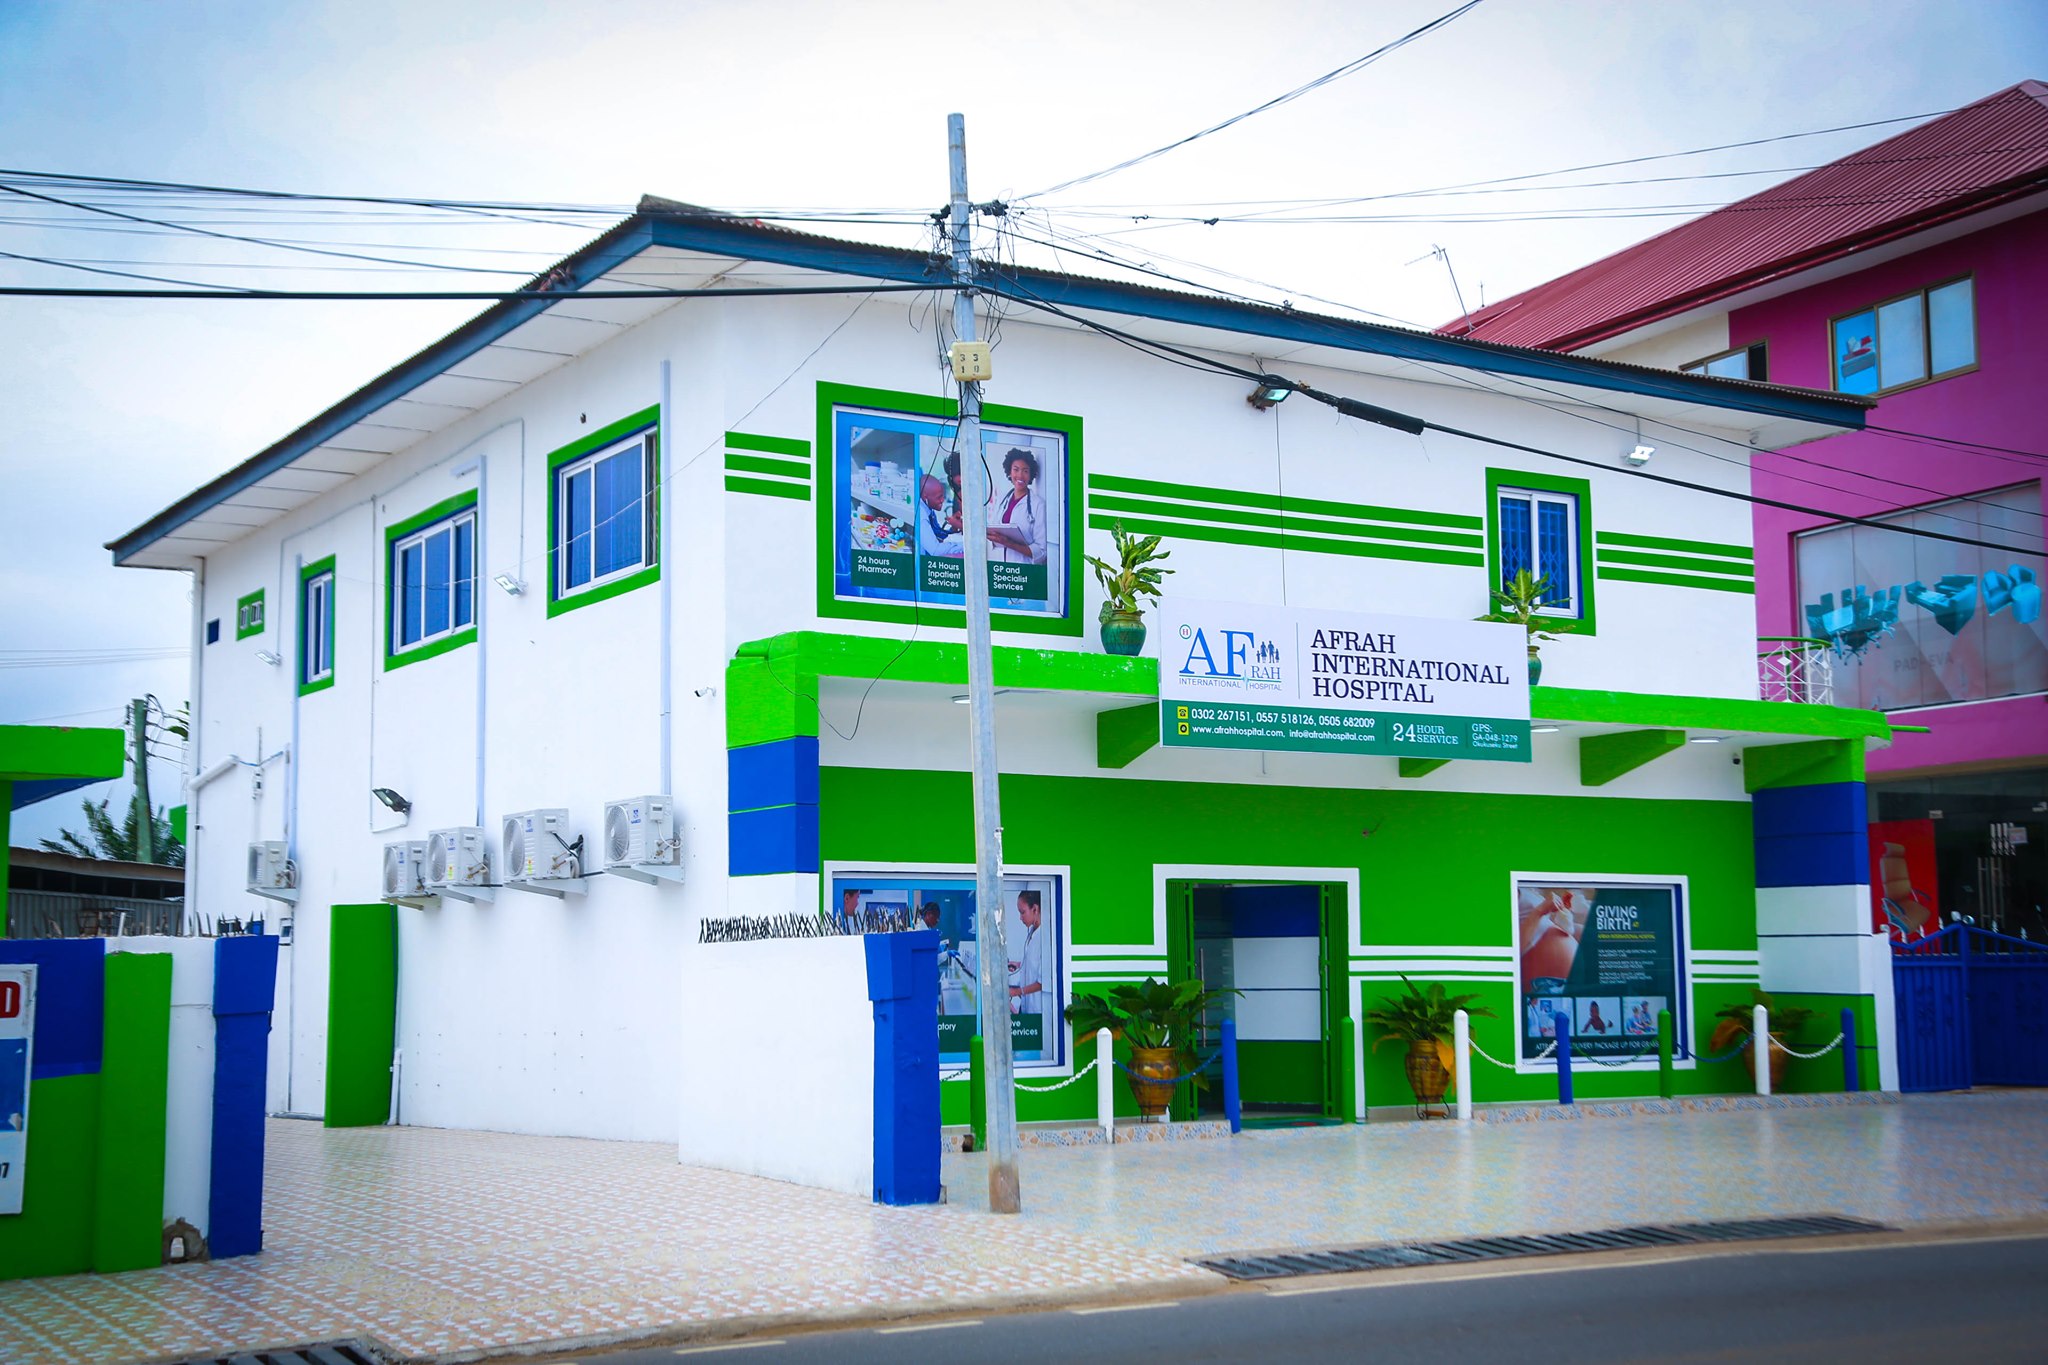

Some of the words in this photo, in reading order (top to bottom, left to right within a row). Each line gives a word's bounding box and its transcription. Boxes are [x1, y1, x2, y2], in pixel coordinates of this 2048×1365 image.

[857, 555, 867, 564] 24
[868, 556, 890, 565] hours
[927, 560, 937, 569] 24
[938, 561, 960, 571] Hours
[857, 564, 897, 576] Pharmacy
[927, 569, 961, 579] Inpatient
[993, 564, 1004, 573] GP
[1005, 566, 1020, 574] and
[927, 578, 959, 588] Services
[993, 573, 1028, 583] Specialist
[993, 581, 1024, 591] Services
[1310, 629, 1396, 654] AFRAH
[1179, 627, 1255, 677] AF
[1251, 665, 1281, 680] RAH
[1312, 652, 1510, 685] INTERNATIONAL
[1179, 677, 1242, 689] INTERNATIONAL
[1249, 682, 1282, 691] HOSPITAL
[1312, 677, 1434, 704] HOSPITAL
[1191, 708, 1215, 720] 0302
[1217, 709, 1254, 723] 267151,
[1256, 712, 1279, 723] 0557
[1281, 713, 1317, 726] 518126,
[1318, 715, 1341, 727] 0505
[1343, 717, 1375, 728] 682009
[1392, 722, 1416, 743] 24
[1416, 724, 1445, 735] HOUR
[1471, 723, 1493, 733] GPS:
[1289, 729, 1375, 742] info@afrahhospital.com
[1416, 734, 1459, 745] SERVICE
[1595, 905, 1638, 919] GIVING
[1596, 917, 1632, 931] BIRTH
